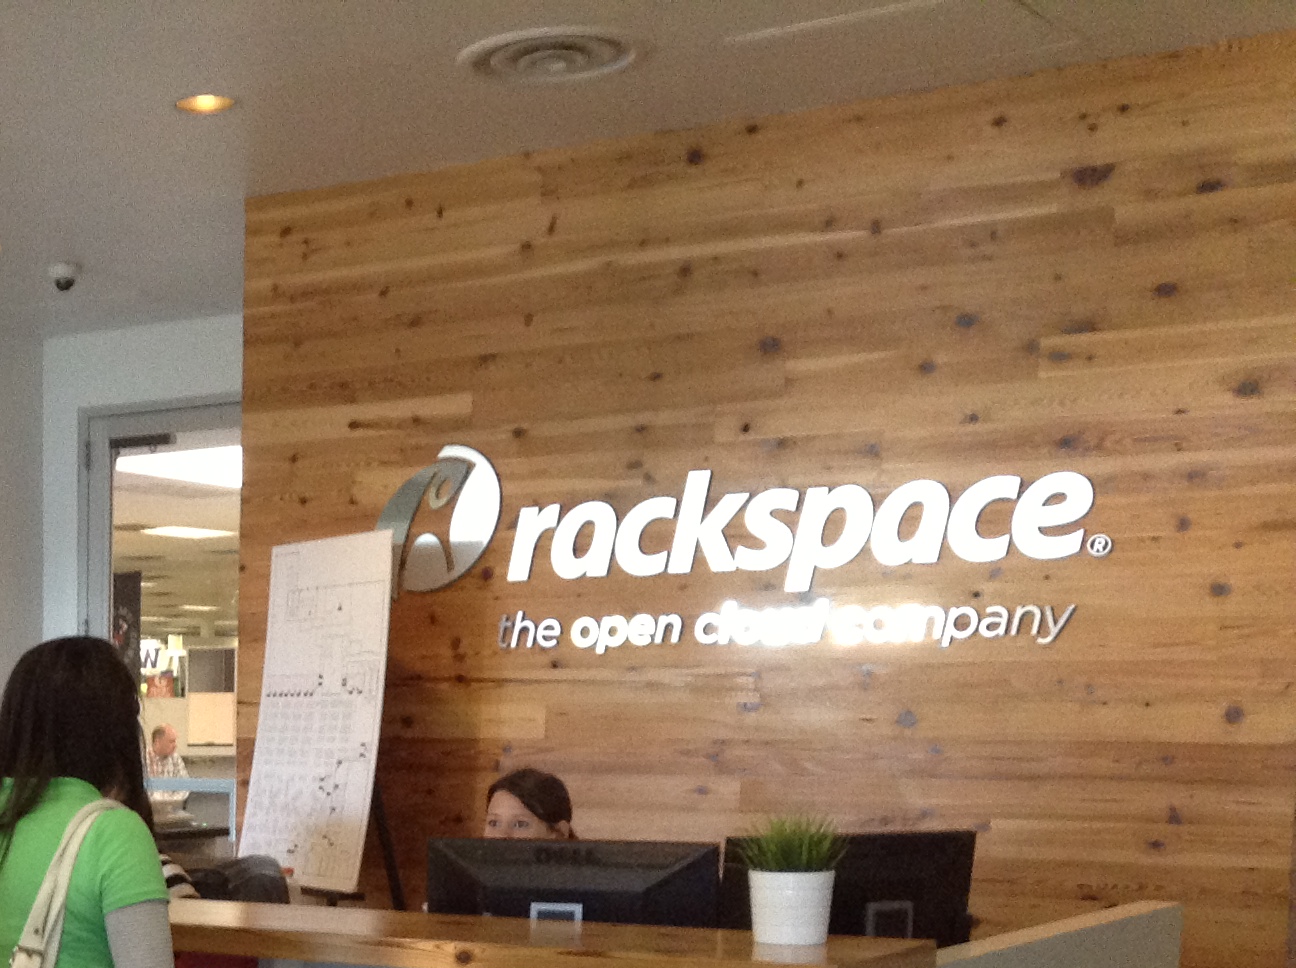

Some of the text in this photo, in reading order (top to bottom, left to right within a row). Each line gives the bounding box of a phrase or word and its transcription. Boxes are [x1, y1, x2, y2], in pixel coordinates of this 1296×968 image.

[498, 611, 562, 650] the
[570, 612, 684, 655] open
[828, 602, 1078, 649] company
